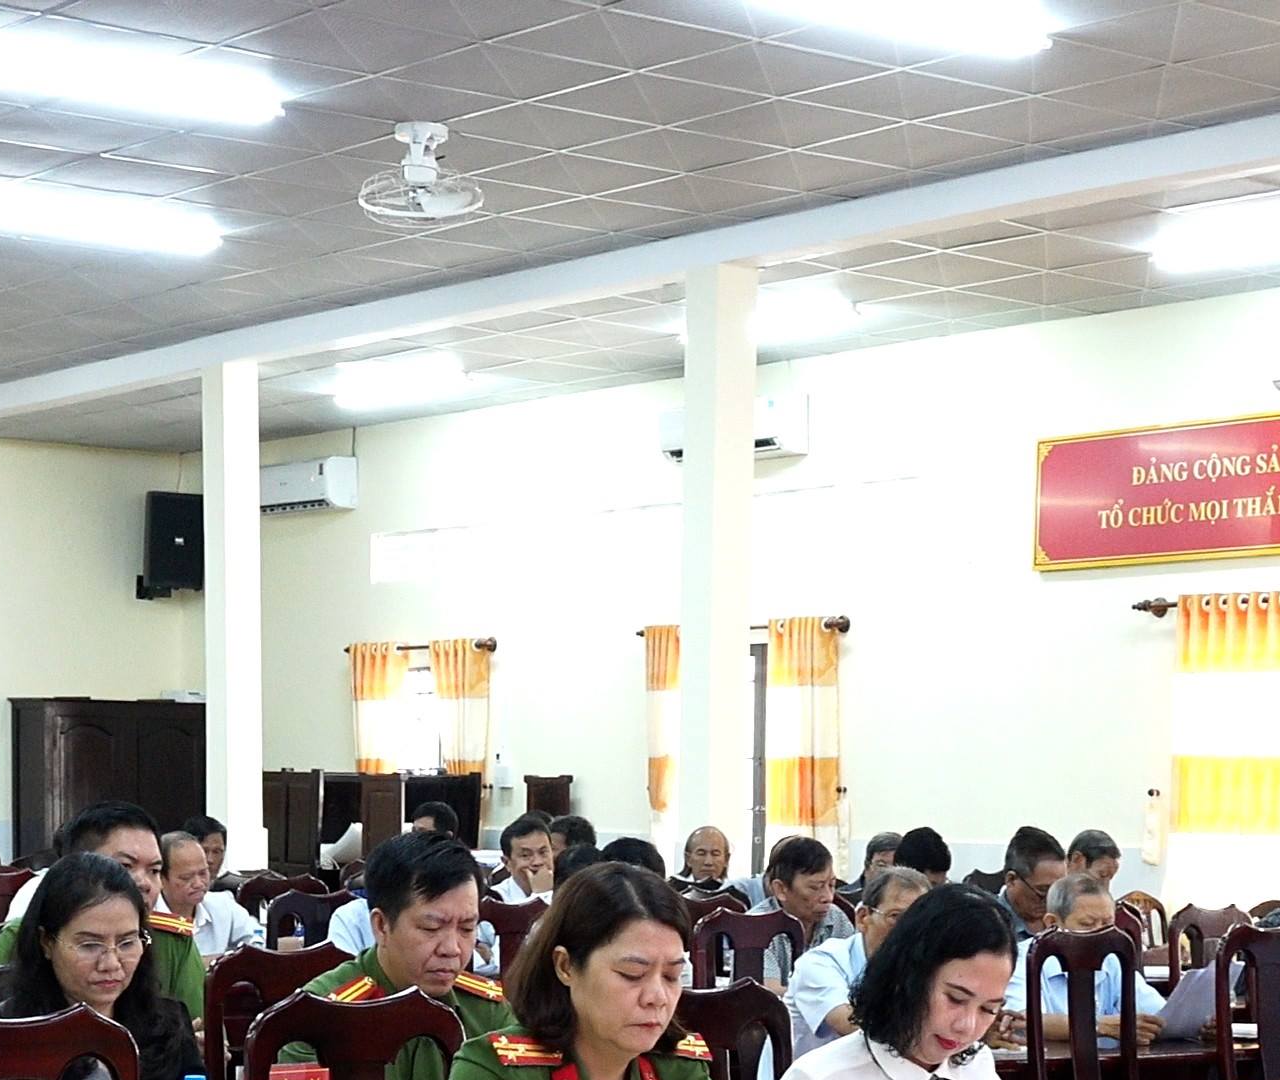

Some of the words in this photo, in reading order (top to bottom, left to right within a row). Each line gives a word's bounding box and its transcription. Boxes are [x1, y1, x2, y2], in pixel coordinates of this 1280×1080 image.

[1132, 457, 1188, 485] ĐẢNG
[1193, 453, 1251, 482] CỘNG
[1098, 499, 1124, 529] TỔ
[1128, 501, 1184, 528] CHỨC
[1189, 499, 1229, 525] MỌI
